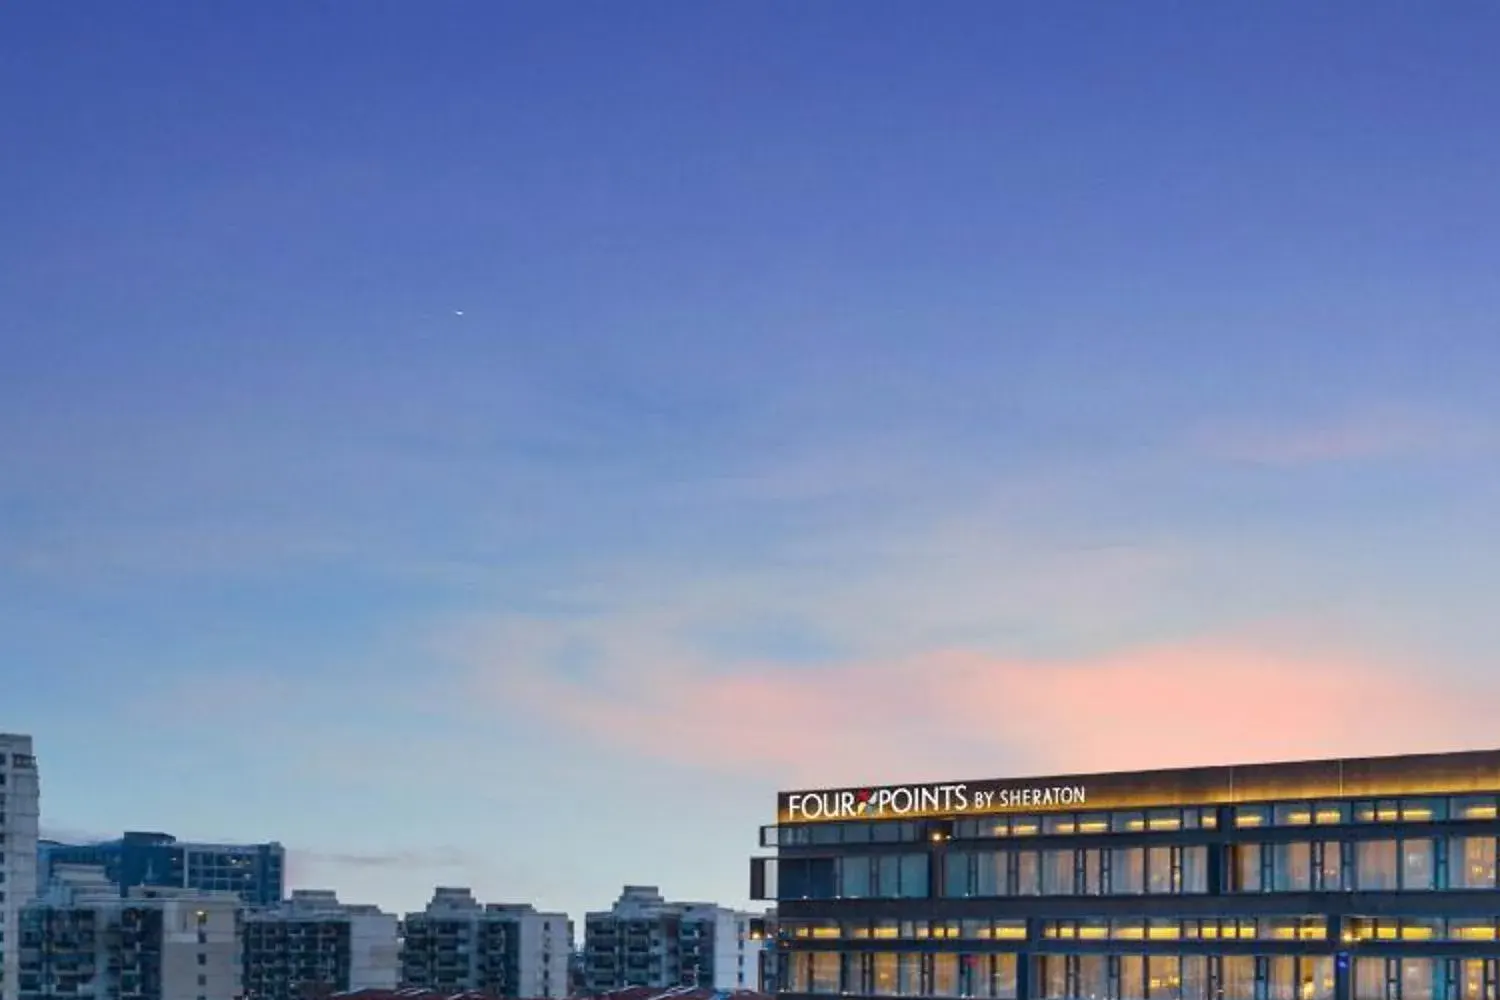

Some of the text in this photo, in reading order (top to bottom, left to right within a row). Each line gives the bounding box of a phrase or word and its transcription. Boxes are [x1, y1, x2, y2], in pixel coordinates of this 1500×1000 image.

[789, 785, 1085, 820] FOUR POINTS BY SHERATON
